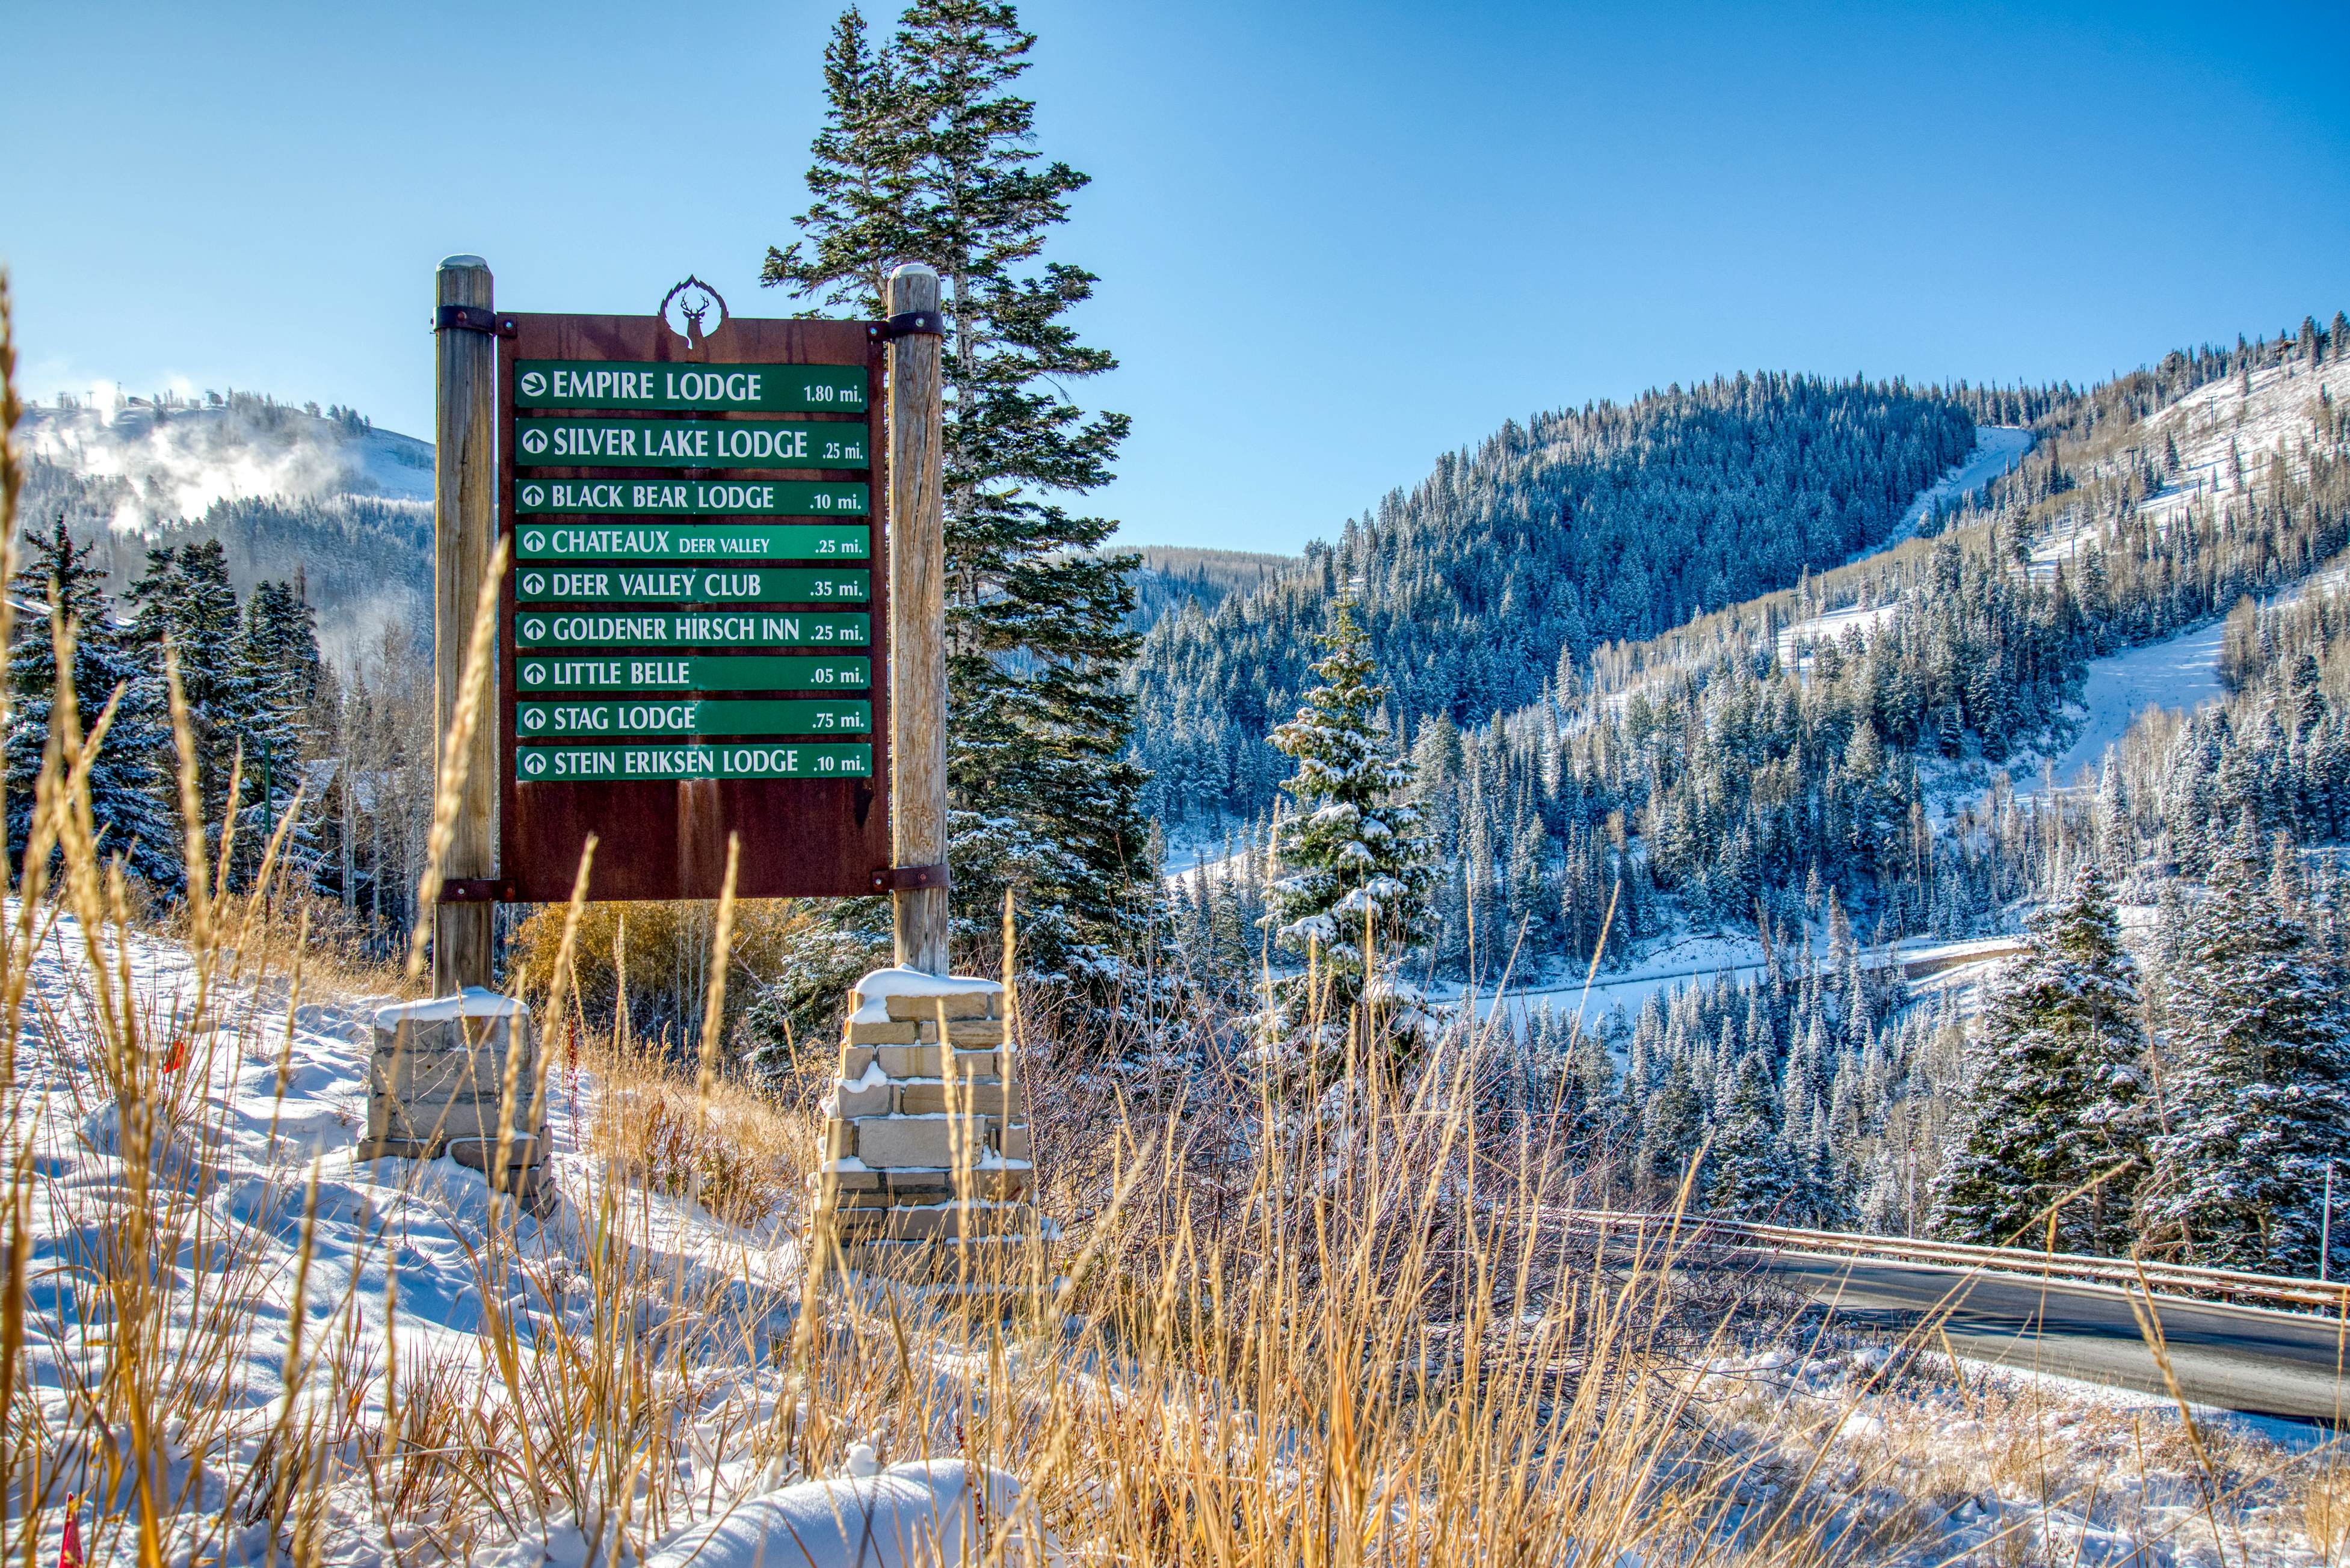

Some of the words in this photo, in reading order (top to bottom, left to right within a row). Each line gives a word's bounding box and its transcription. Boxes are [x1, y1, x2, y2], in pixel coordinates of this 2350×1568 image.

[554, 370, 653, 399] EMPIRE
[667, 373, 761, 401] LODGE
[804, 385, 833, 402] 1.80
[840, 385, 862, 402] mi.
[554, 428, 637, 456] SILVER
[644, 429, 708, 457] LAKE
[718, 430, 807, 458] LODGE
[822, 442, 840, 459] .25
[845, 442, 863, 460] mi.
[552, 485, 623, 508] BLACK
[634, 486, 688, 508] BEAR
[699, 486, 773, 508] LODGE
[810, 494, 831, 509] .10
[838, 494, 861, 509] mi.
[552, 530, 669, 553] CHATEAUX
[679, 538, 716, 553] DEER
[720, 538, 769, 553] VALLEY
[815, 539, 836, 553] .25
[841, 539, 862, 553] mi.
[553, 574, 609, 595] DEER
[618, 574, 695, 596] VALLEY
[705, 574, 761, 597] CLUB
[810, 580, 832, 596] .35
[839, 580, 863, 597] mi.
[553, 618, 667, 641] GOLDENER
[676, 618, 754, 641] HIRSCH
[763, 618, 799, 640] INN
[810, 625, 833, 641] .25
[840, 625, 863, 641] mi.
[554, 663, 621, 684] LITTLE
[631, 662, 689, 684] BELLE
[810, 668, 833, 683] .05
[840, 667, 864, 683] mi.
[554, 707, 608, 730] STAG
[618, 706, 695, 729] LODGE
[812, 712, 834, 728] .75
[840, 712, 864, 728] mi.
[555, 751, 615, 775] STEIN
[625, 751, 714, 773] ERIKSEN
[723, 749, 798, 773] LODGE
[813, 755, 834, 771] .10
[841, 755, 865, 771] mi.
